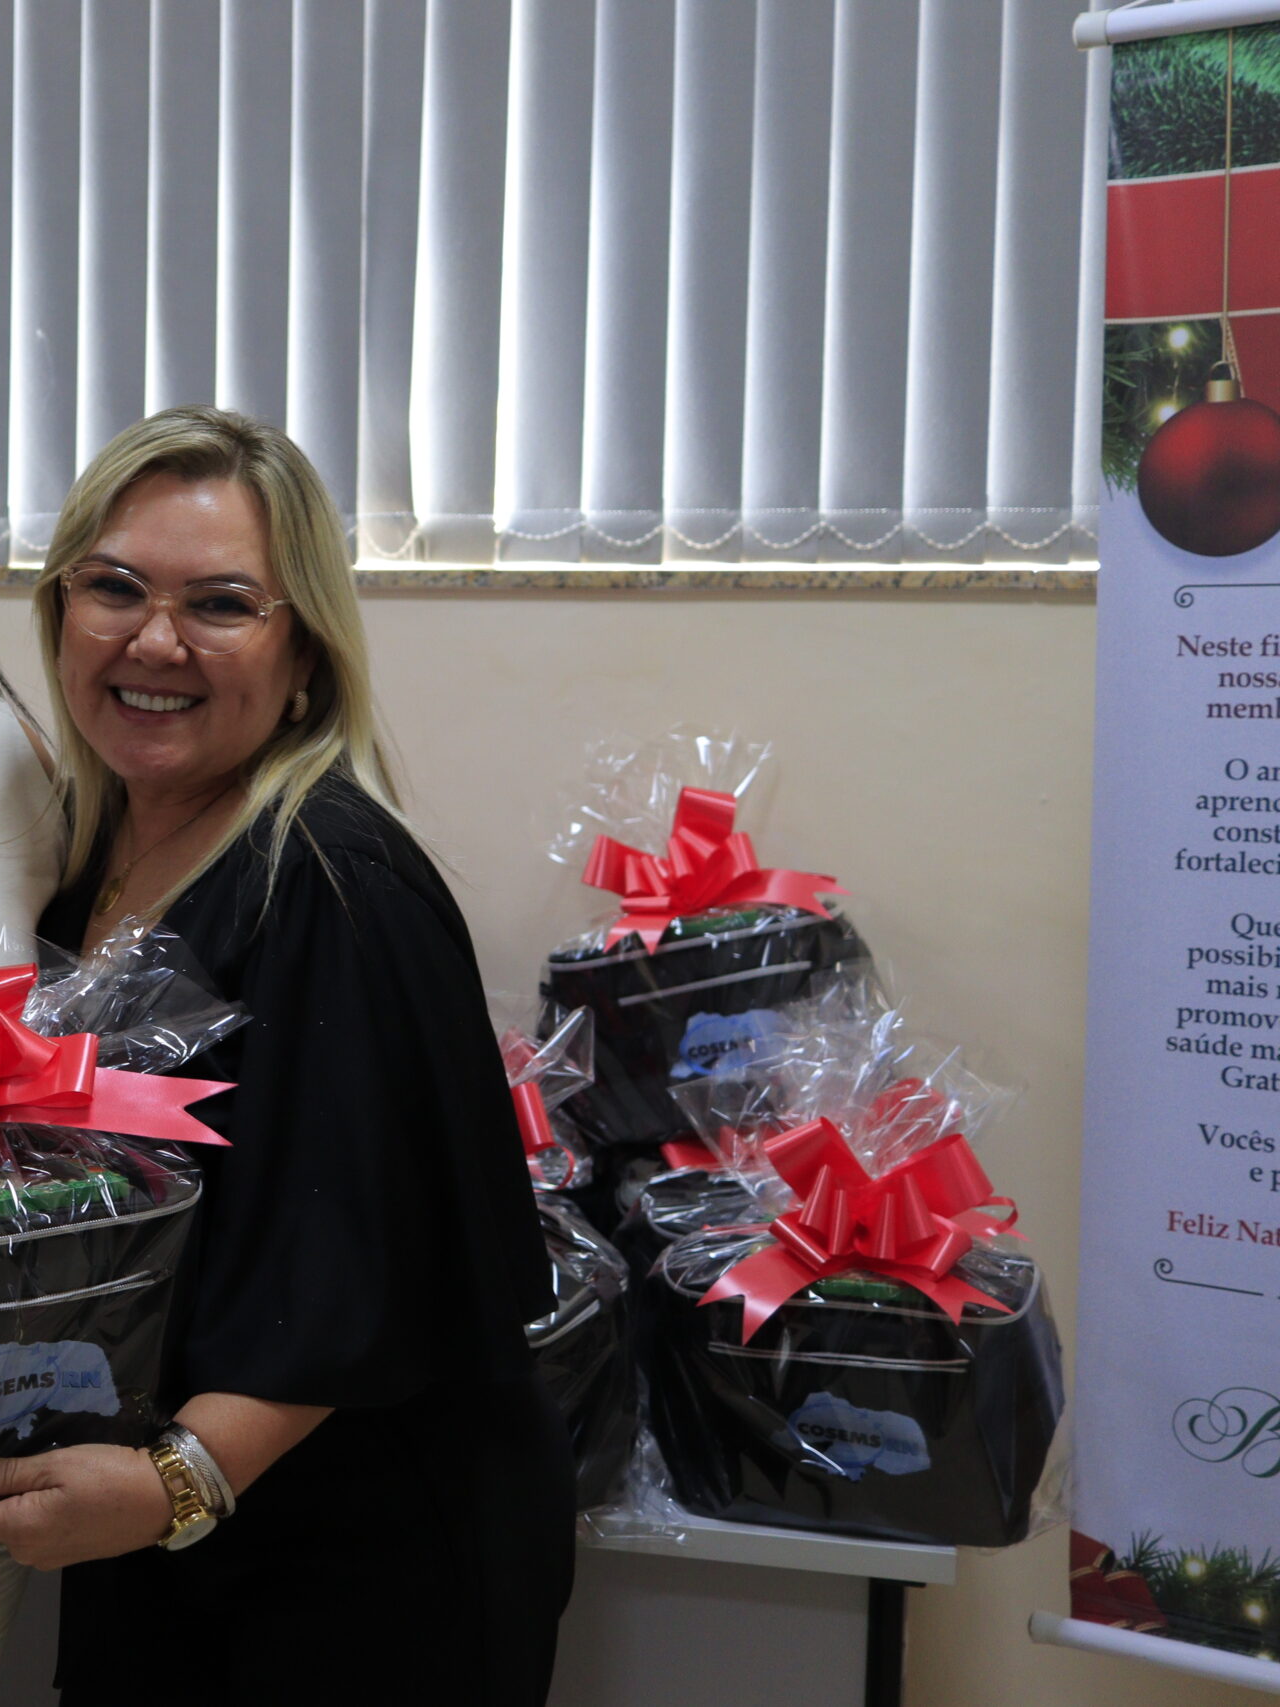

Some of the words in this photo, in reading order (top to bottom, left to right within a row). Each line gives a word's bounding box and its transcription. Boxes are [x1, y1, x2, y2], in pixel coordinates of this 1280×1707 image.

[1177, 634, 1253, 657] Neste
[1218, 671, 1280, 689] noss
[1225, 758, 1249, 781] O
[1186, 944, 1280, 970] possibi
[1206, 975, 1268, 998] mais
[1166, 1032, 1243, 1058] saúde
[1221, 1065, 1280, 1092] Grat
[1198, 1123, 1276, 1154] Vocês
[1249, 1166, 1263, 1182] e
[1167, 1210, 1230, 1240] Feliz
[62, 1370, 102, 1389] RN
[796, 1421, 883, 1449] COSEMS
